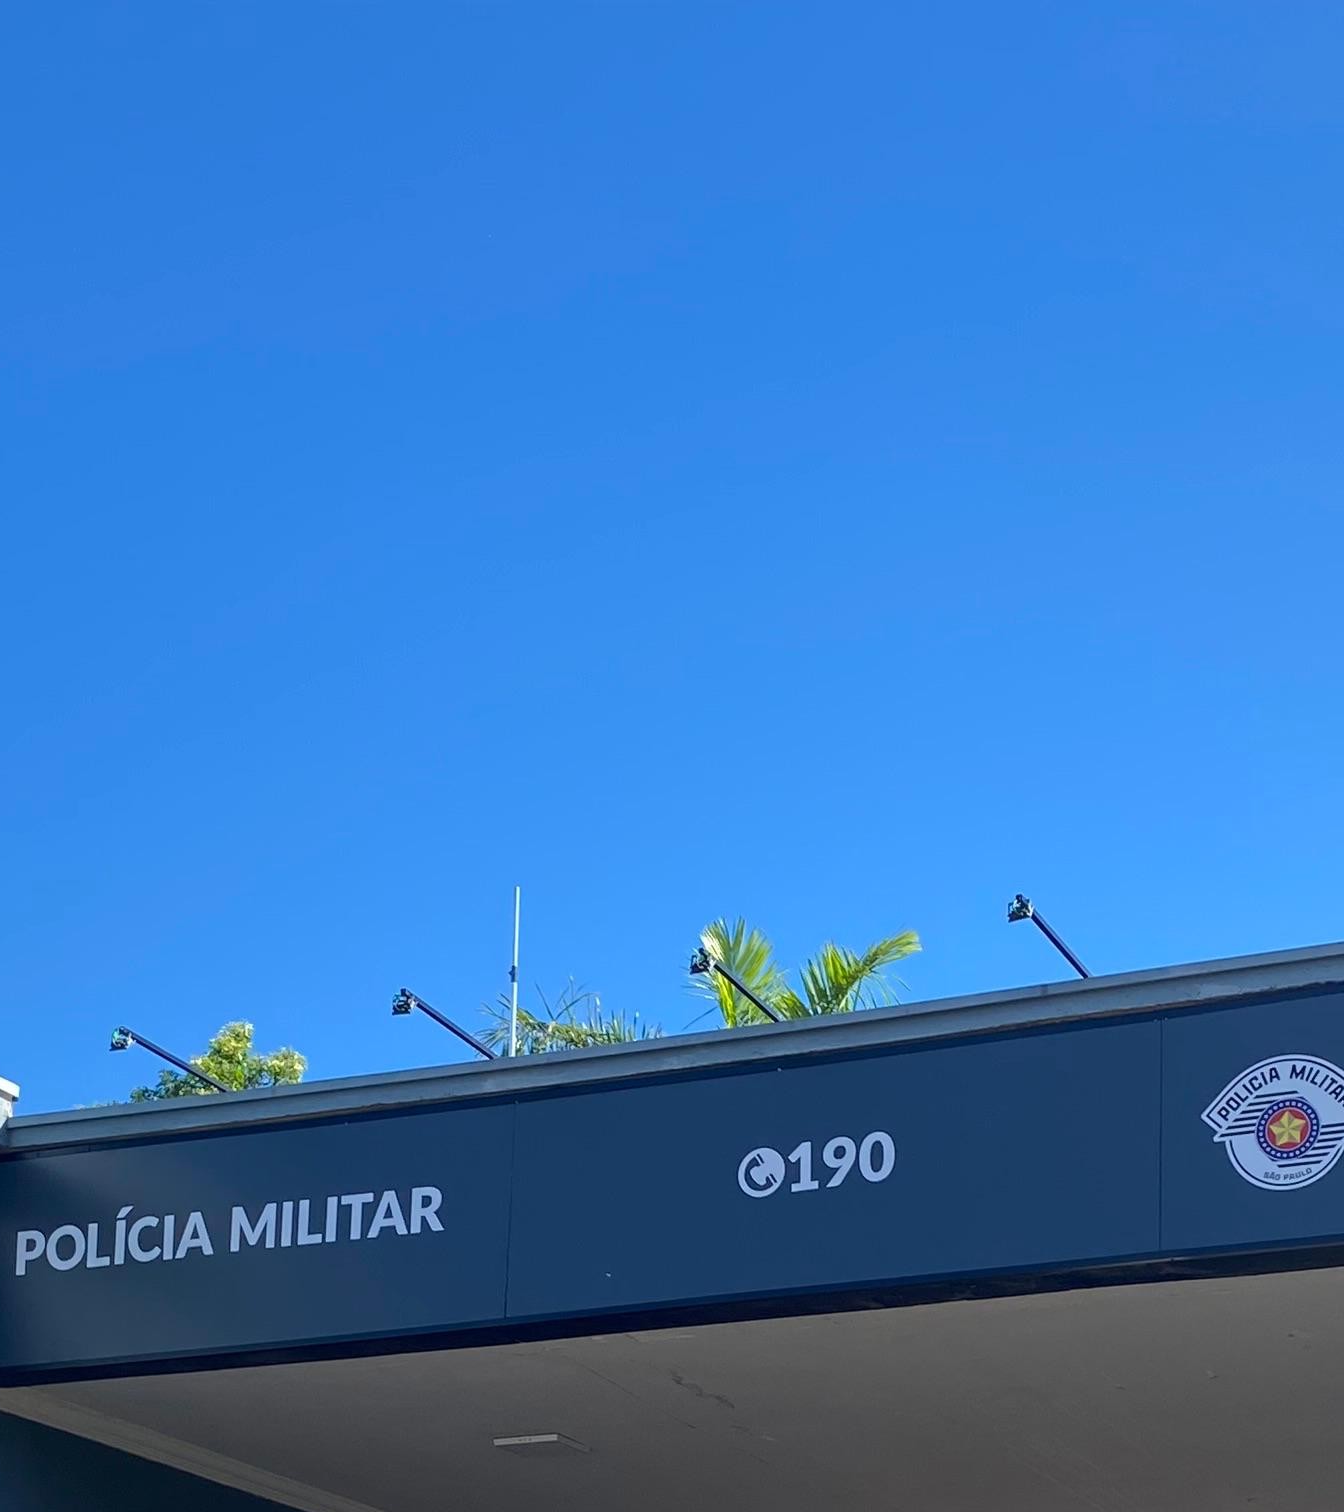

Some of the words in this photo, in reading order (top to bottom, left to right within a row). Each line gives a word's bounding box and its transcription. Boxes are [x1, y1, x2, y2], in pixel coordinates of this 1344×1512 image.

[787, 1131, 896, 1193] 190
[1263, 1171, 1281, 1181] SÃO
[1283, 1167, 1313, 1181] PAULO
[15, 1205, 214, 1276] POLÍCIA
[229, 1186, 445, 1253] MILITAR
